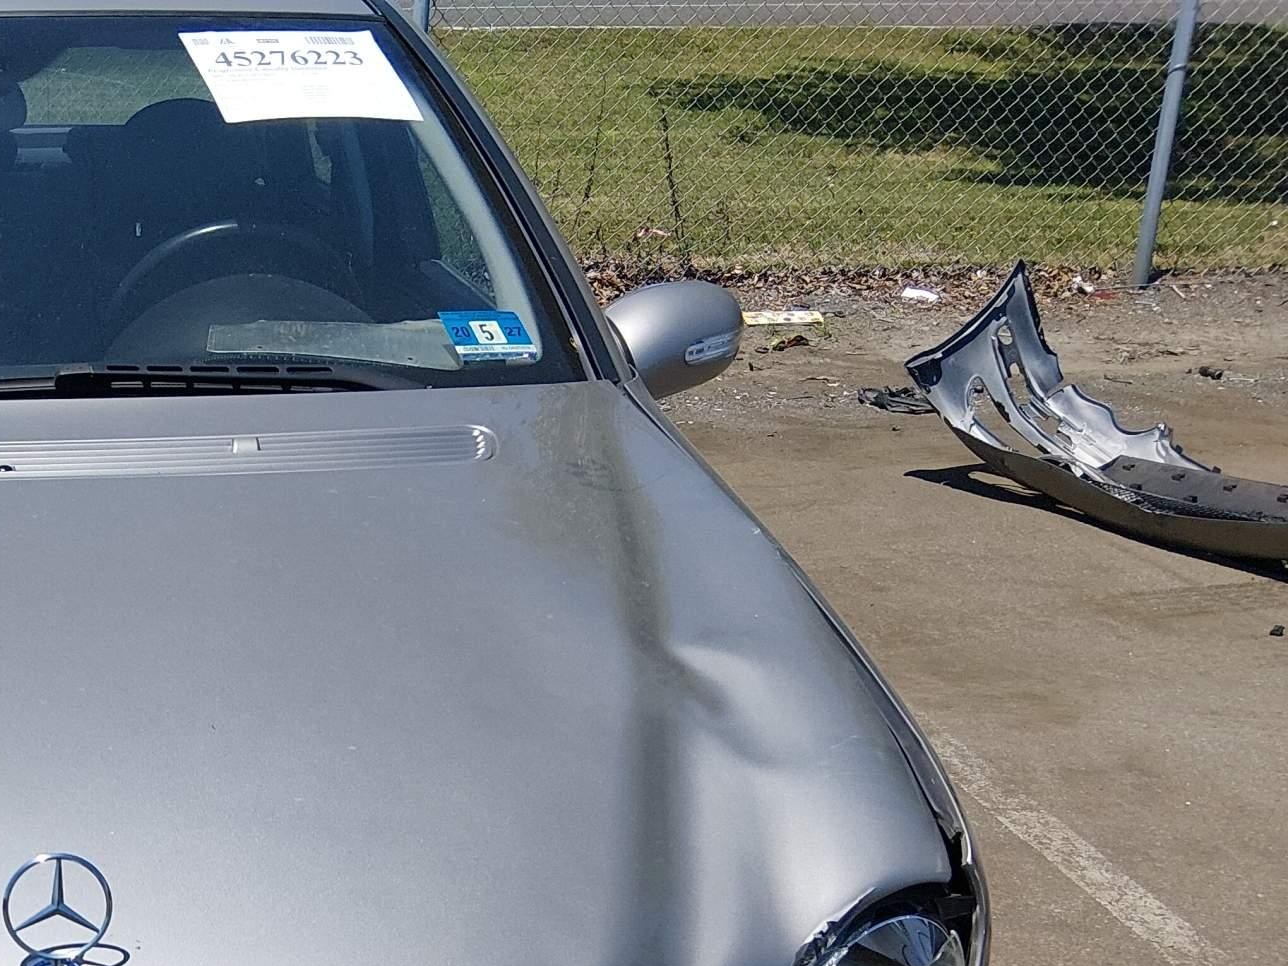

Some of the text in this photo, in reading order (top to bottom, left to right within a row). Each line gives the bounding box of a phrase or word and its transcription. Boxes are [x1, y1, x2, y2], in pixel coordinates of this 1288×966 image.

[215, 50, 364, 67] 45276223
[451, 324, 522, 341] 20 5 27
